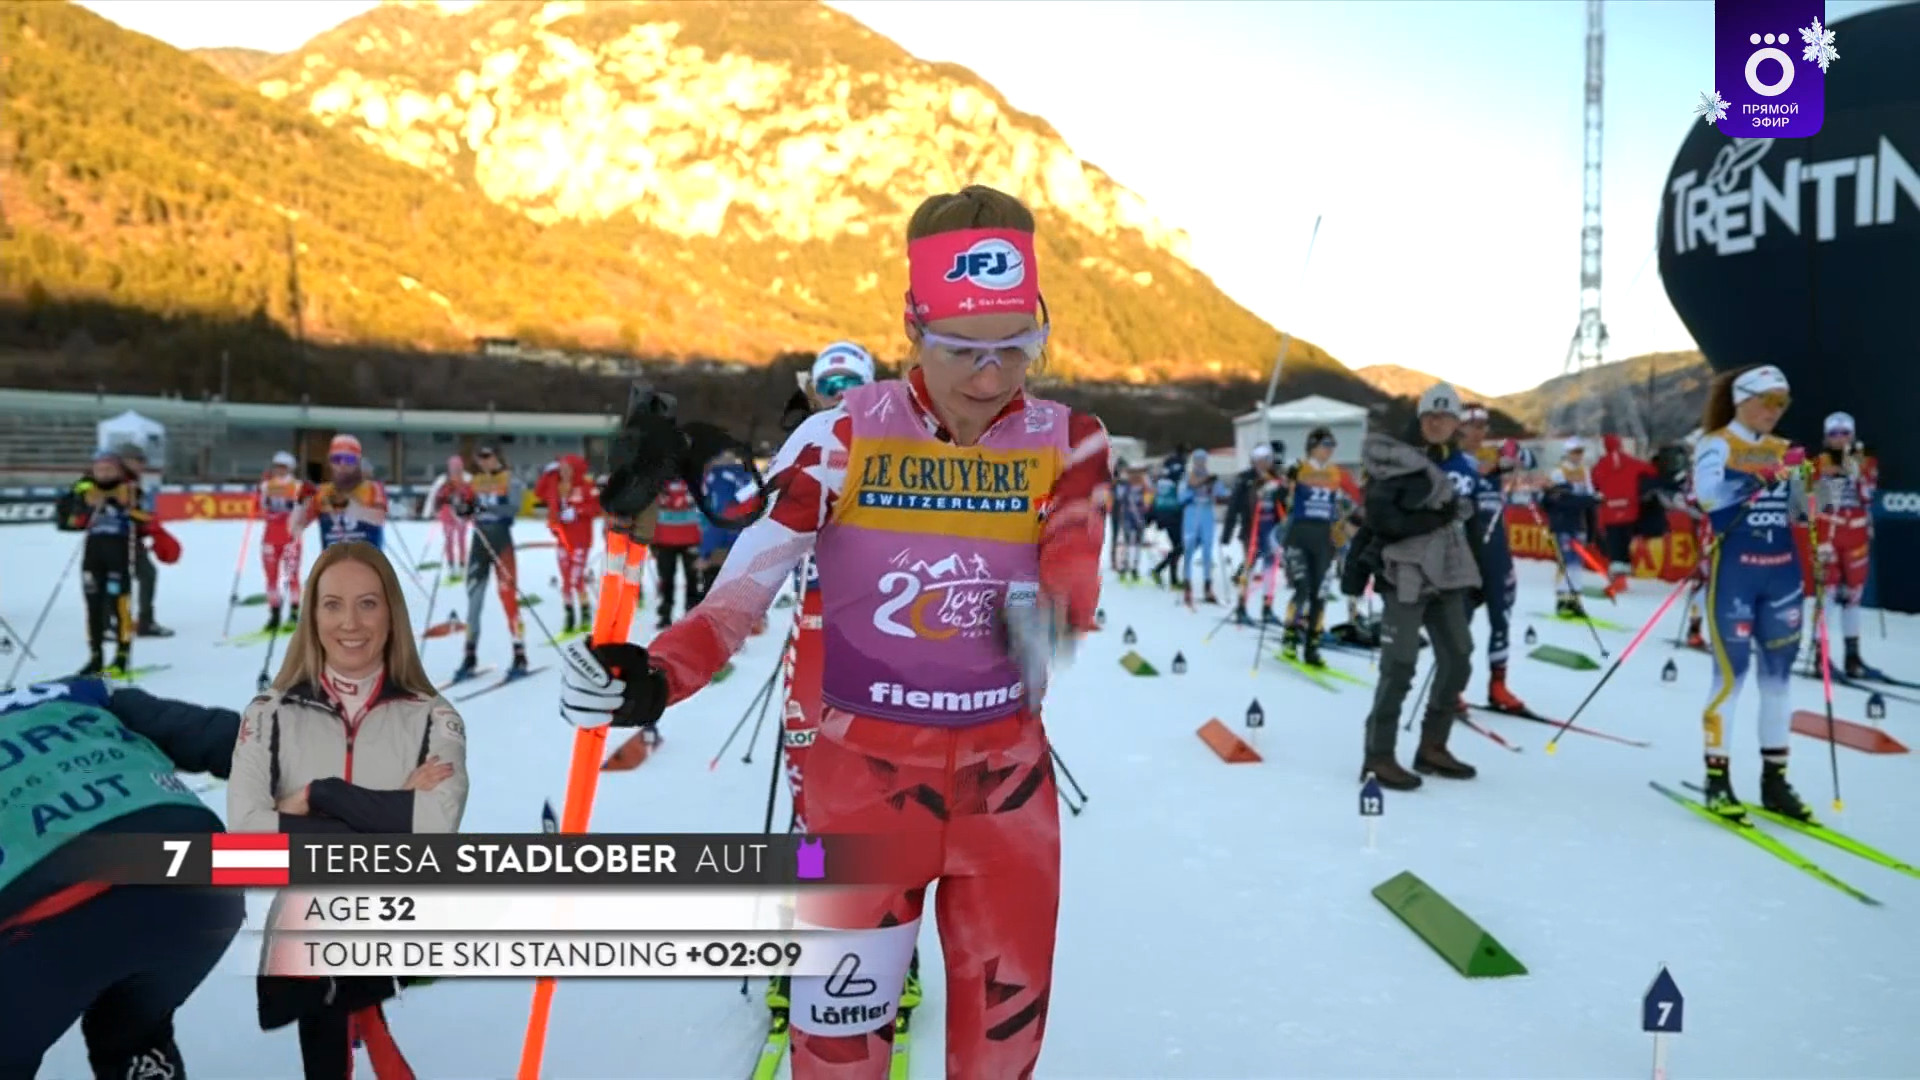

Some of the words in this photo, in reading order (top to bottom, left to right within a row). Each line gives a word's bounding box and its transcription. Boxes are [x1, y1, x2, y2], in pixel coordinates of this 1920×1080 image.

[947, 252, 1008, 280] JFJ
[863, 454, 892, 487] LE
[865, 492, 1023, 511] SWITZERLAND
[31, 772, 131, 839] AUT
[810, 1001, 890, 1025] Löffler
[1657, 1002, 1674, 1027] 7
